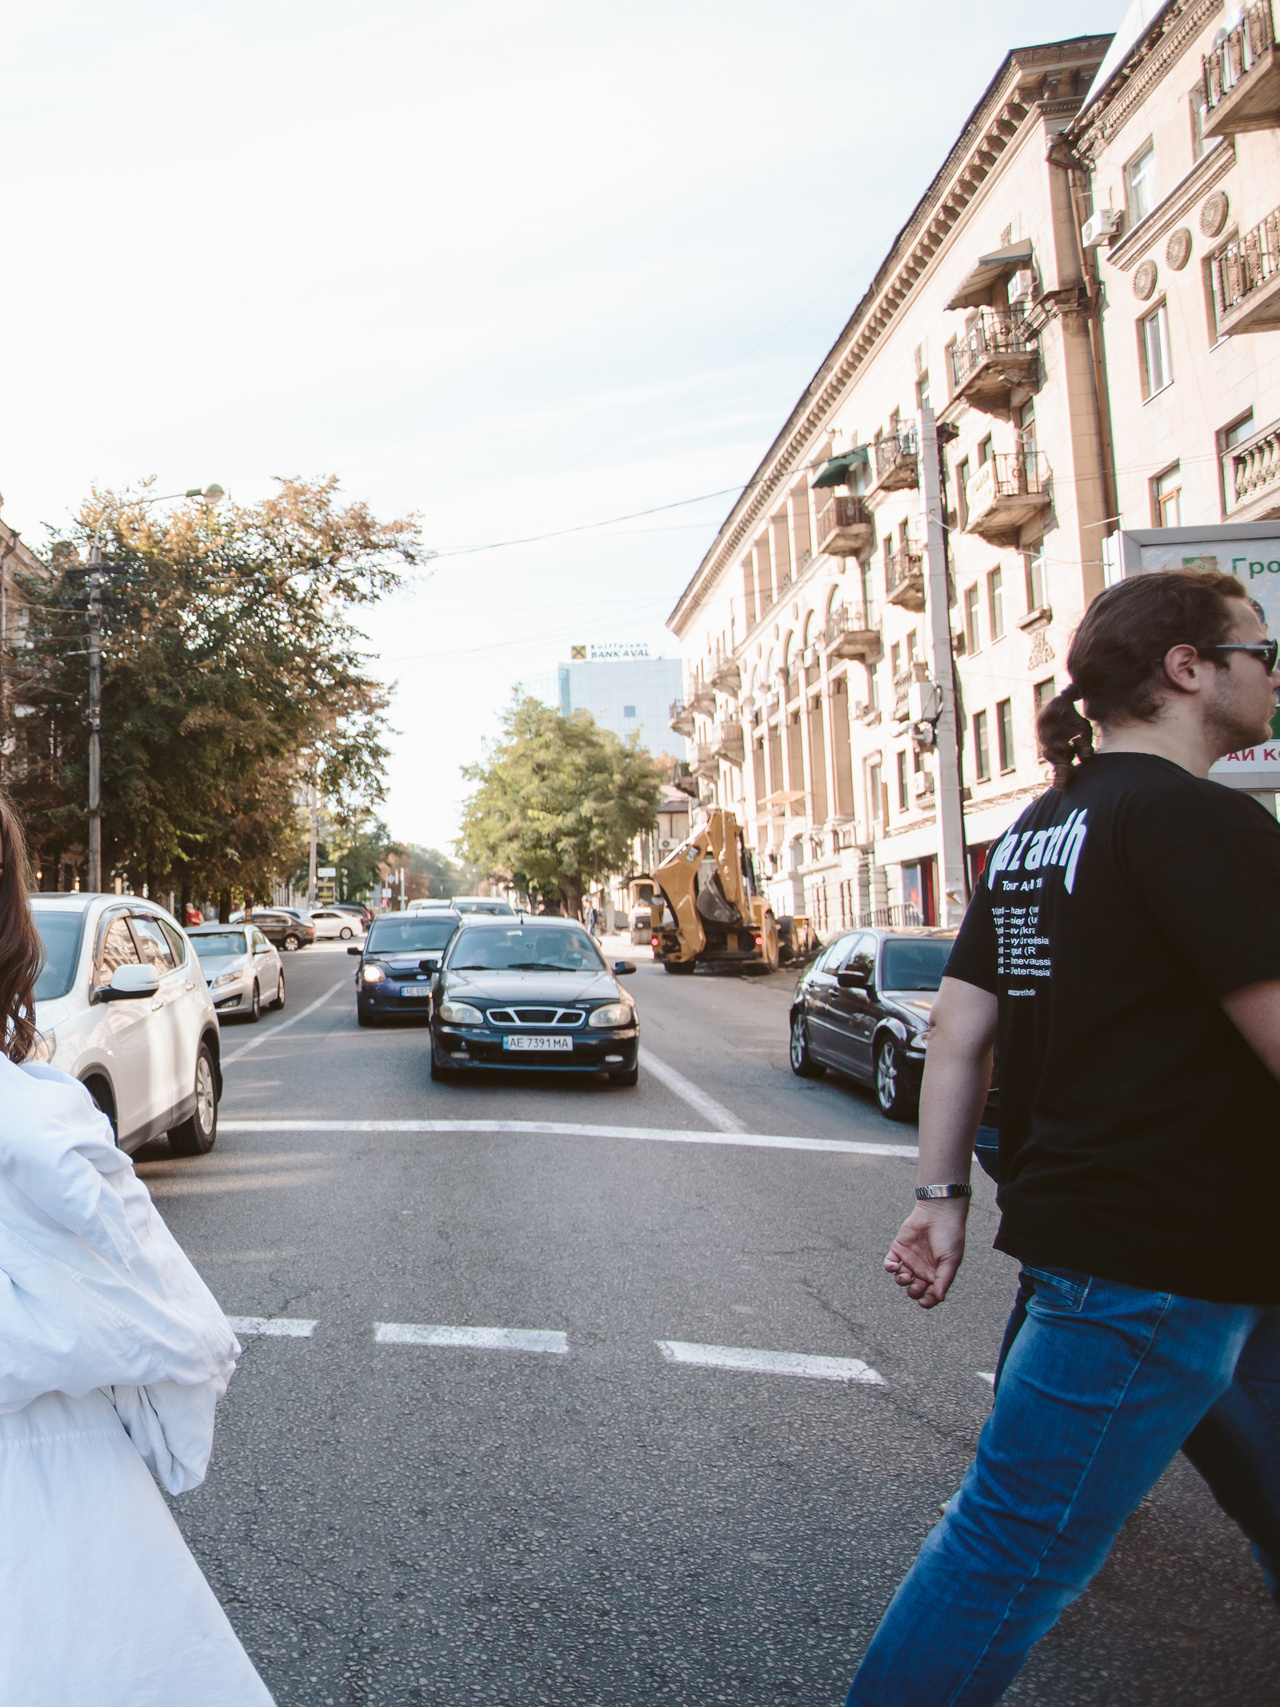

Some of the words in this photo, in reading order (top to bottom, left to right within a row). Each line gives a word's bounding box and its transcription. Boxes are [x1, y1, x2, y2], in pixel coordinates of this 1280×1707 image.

[591, 650, 620, 658] BANK
[623, 649, 650, 658] AVAL
[509, 1037, 524, 1048] AE
[527, 1038, 551, 1049] 7391
[553, 1039, 569, 1049] MA
